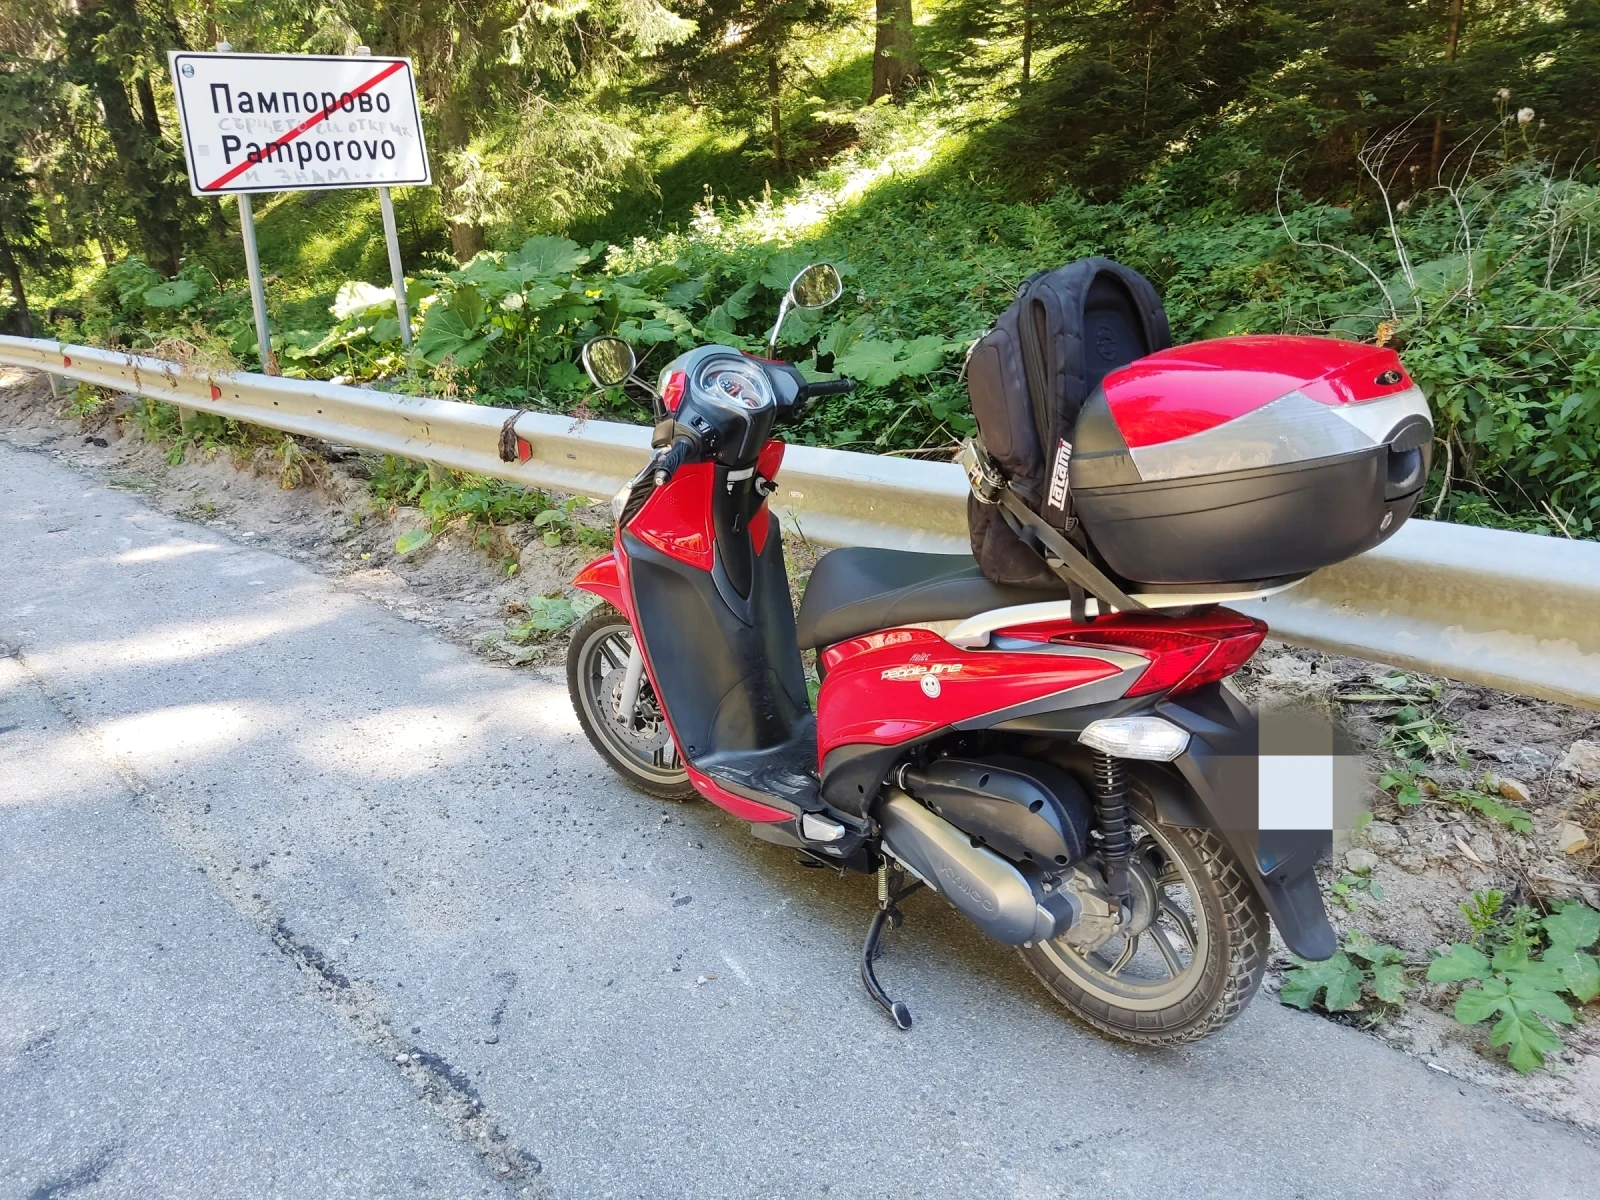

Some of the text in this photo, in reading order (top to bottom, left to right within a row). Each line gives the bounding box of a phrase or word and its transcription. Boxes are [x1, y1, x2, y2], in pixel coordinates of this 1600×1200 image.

[209, 82, 391, 120] Пампорово
[221, 134, 397, 170] Pamporovo
[1047, 437, 1073, 512] Tatami
[940, 863, 994, 912] KYMCO
